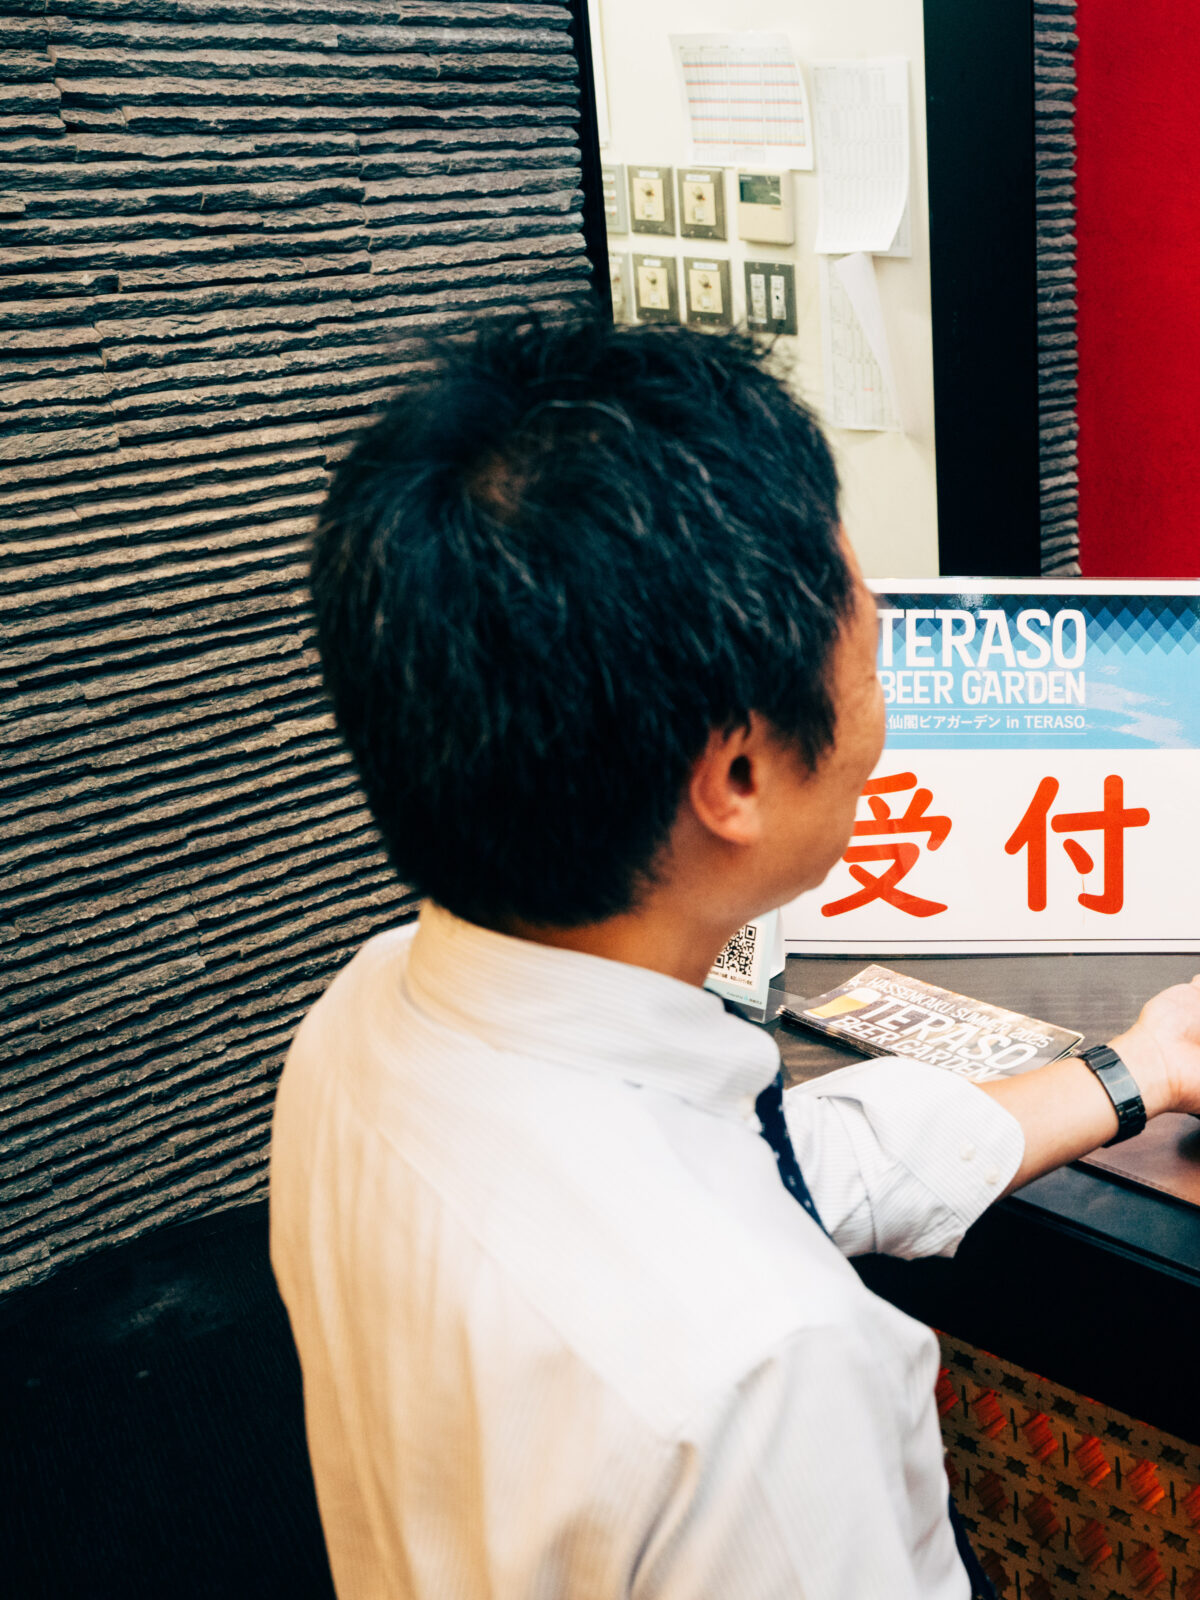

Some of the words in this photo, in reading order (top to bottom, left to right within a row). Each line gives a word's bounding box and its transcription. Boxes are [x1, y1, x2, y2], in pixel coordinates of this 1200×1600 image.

[876, 608, 1087, 669] TERASO
[879, 671, 954, 704] BEER
[962, 670, 1086, 705] GARDEN
[1006, 715, 1020, 729] in
[1024, 714, 1086, 730] TERASO
[821, 771, 1150, 918] 受付
[860, 995, 1038, 1070] TERASO
[865, 977, 956, 1014] HASSENKAKU
[953, 1008, 1012, 1033] SUMMER
[1008, 1026, 1054, 1049] 2025
[829, 1015, 901, 1043] BEER
[892, 1039, 1001, 1082] GARDEN
